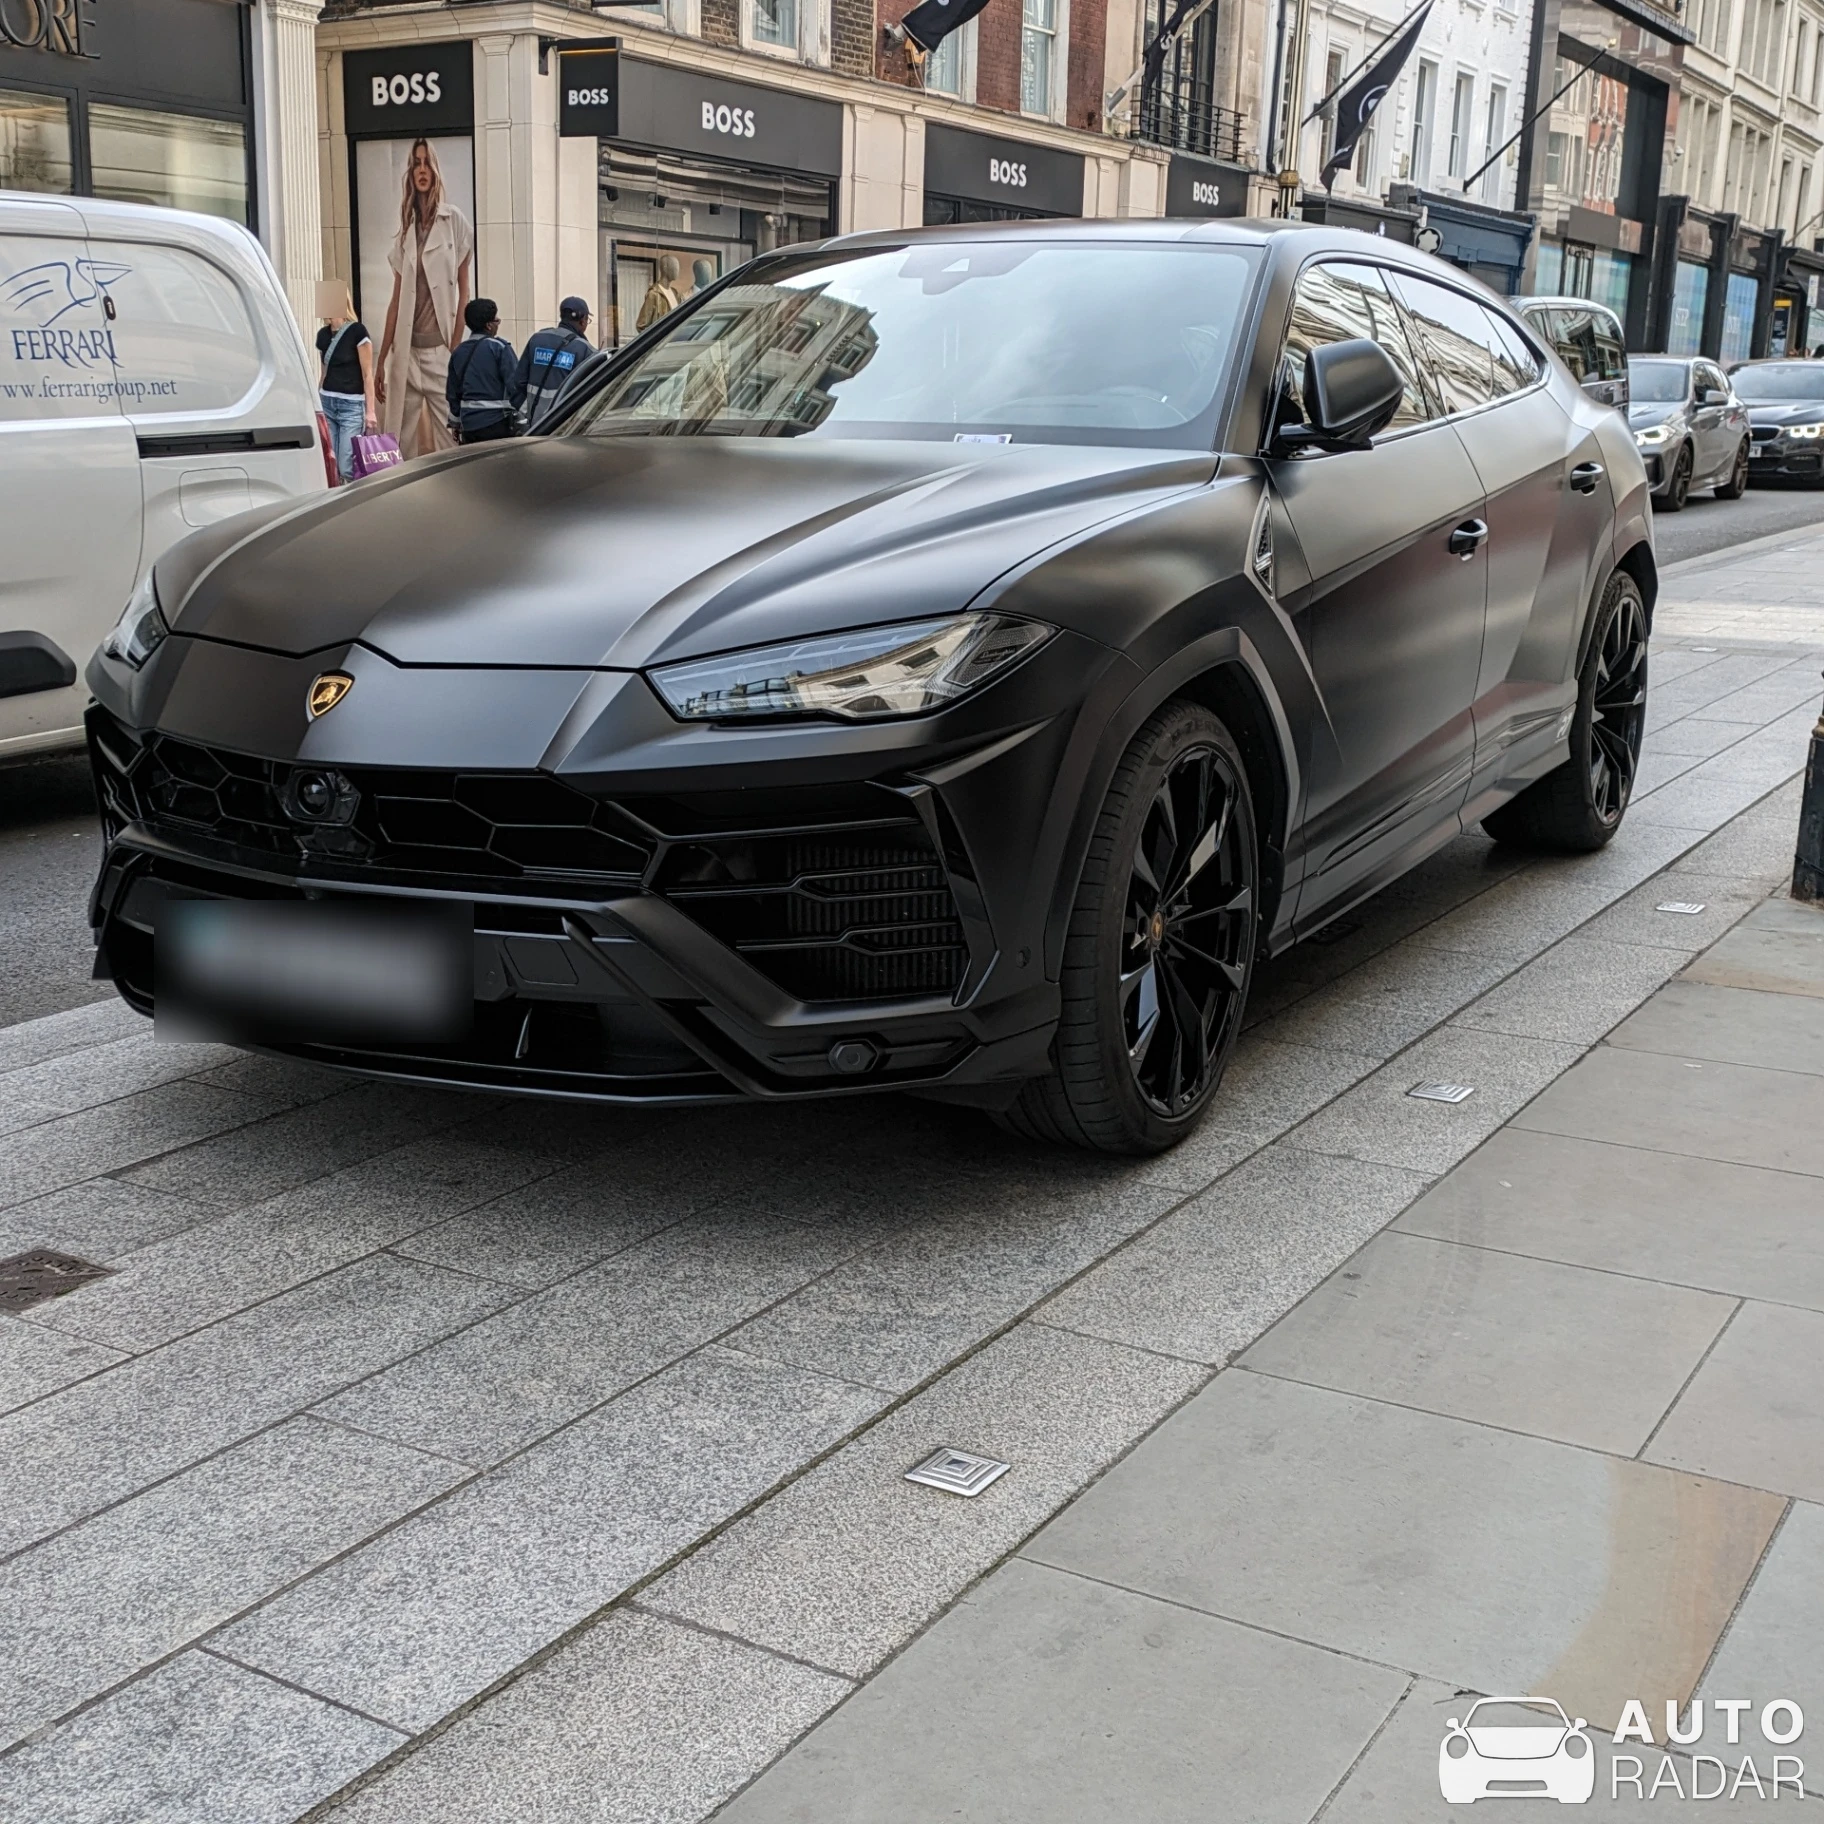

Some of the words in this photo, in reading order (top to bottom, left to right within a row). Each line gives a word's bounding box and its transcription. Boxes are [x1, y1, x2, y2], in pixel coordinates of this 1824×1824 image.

[0, 0, 101, 59] ORE
[372, 71, 442, 106] BOSS
[568, 88, 609, 105] BOSS
[702, 101, 756, 138] BOSS
[990, 158, 1027, 187] BOSS
[1192, 181, 1219, 206] BOSS
[11, 329, 125, 369] FERRARI
[0, 375, 178, 404] ww.ferrarigroup.net
